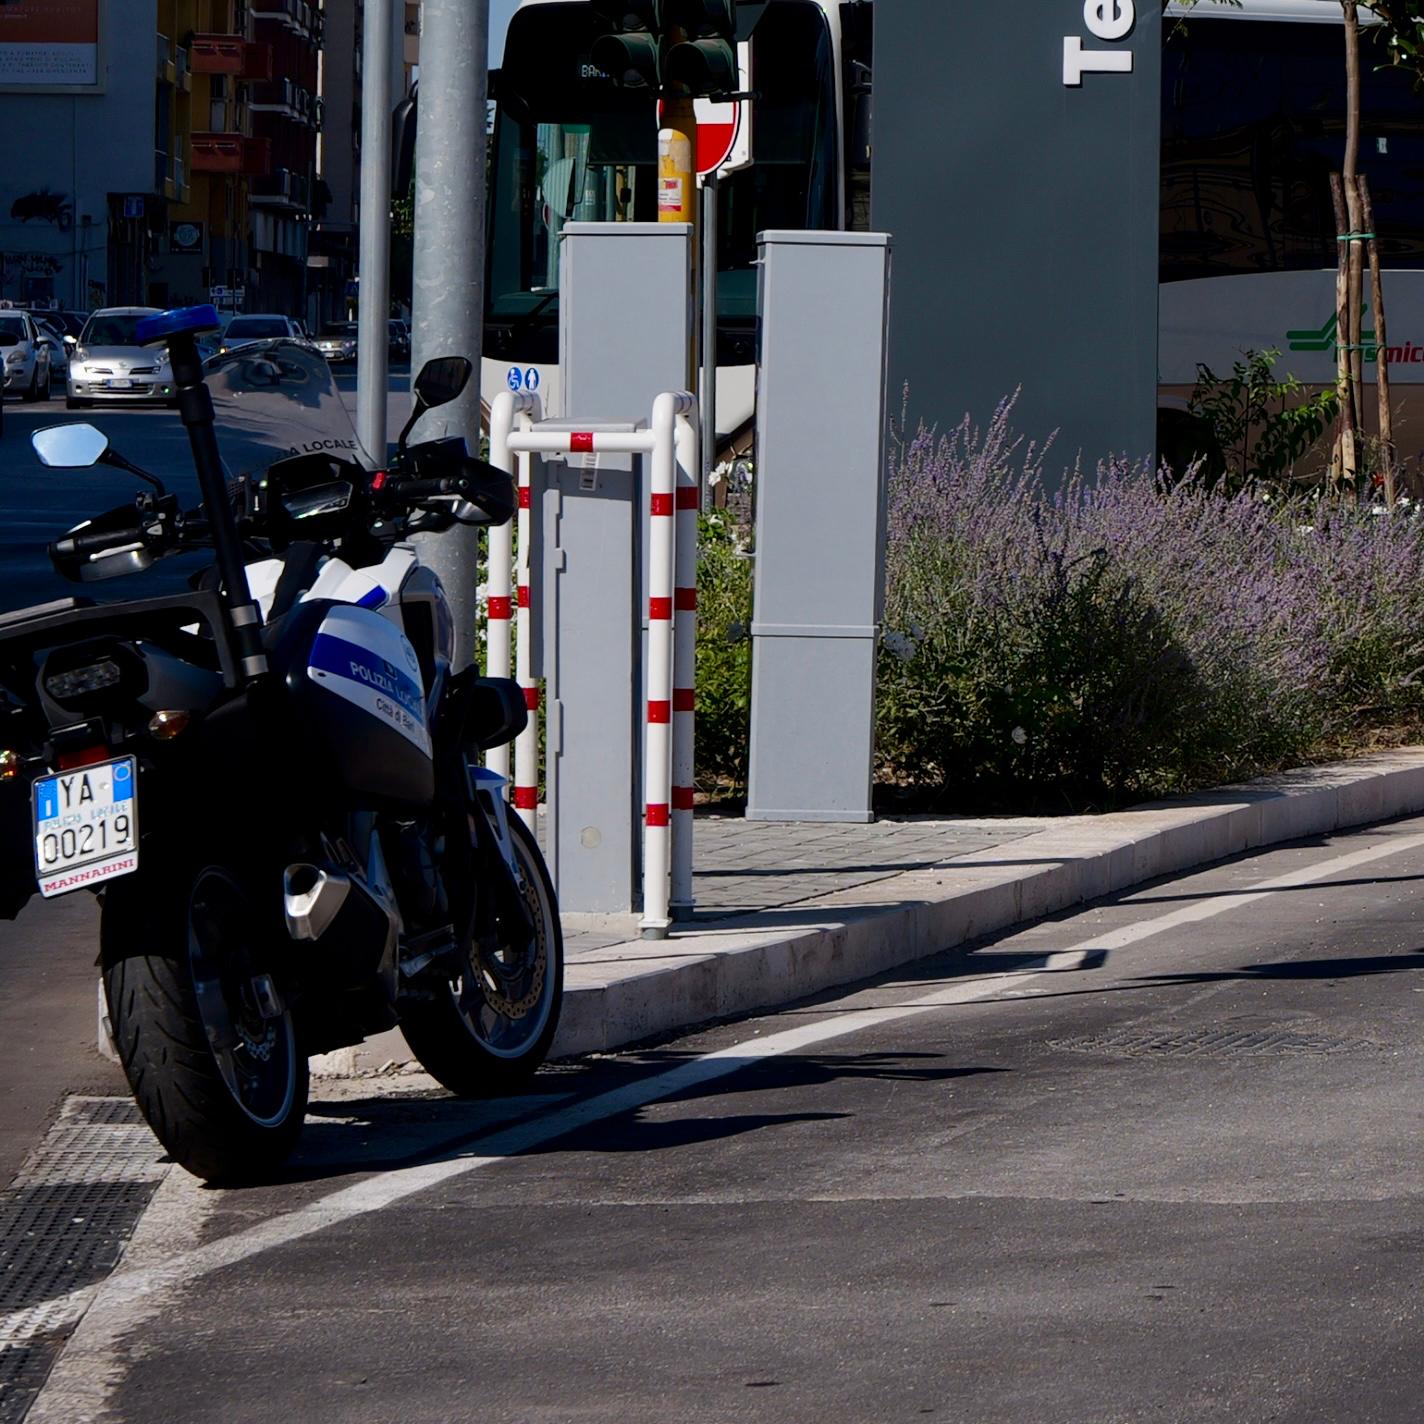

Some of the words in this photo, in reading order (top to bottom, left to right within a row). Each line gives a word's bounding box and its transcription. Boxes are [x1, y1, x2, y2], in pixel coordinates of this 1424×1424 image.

[302, 439, 359, 453] LOCALE
[349, 661, 394, 694] POLIZIA
[61, 773, 94, 808] YA
[43, 814, 130, 864] 00219
[44, 858, 135, 893] MANNARINI
